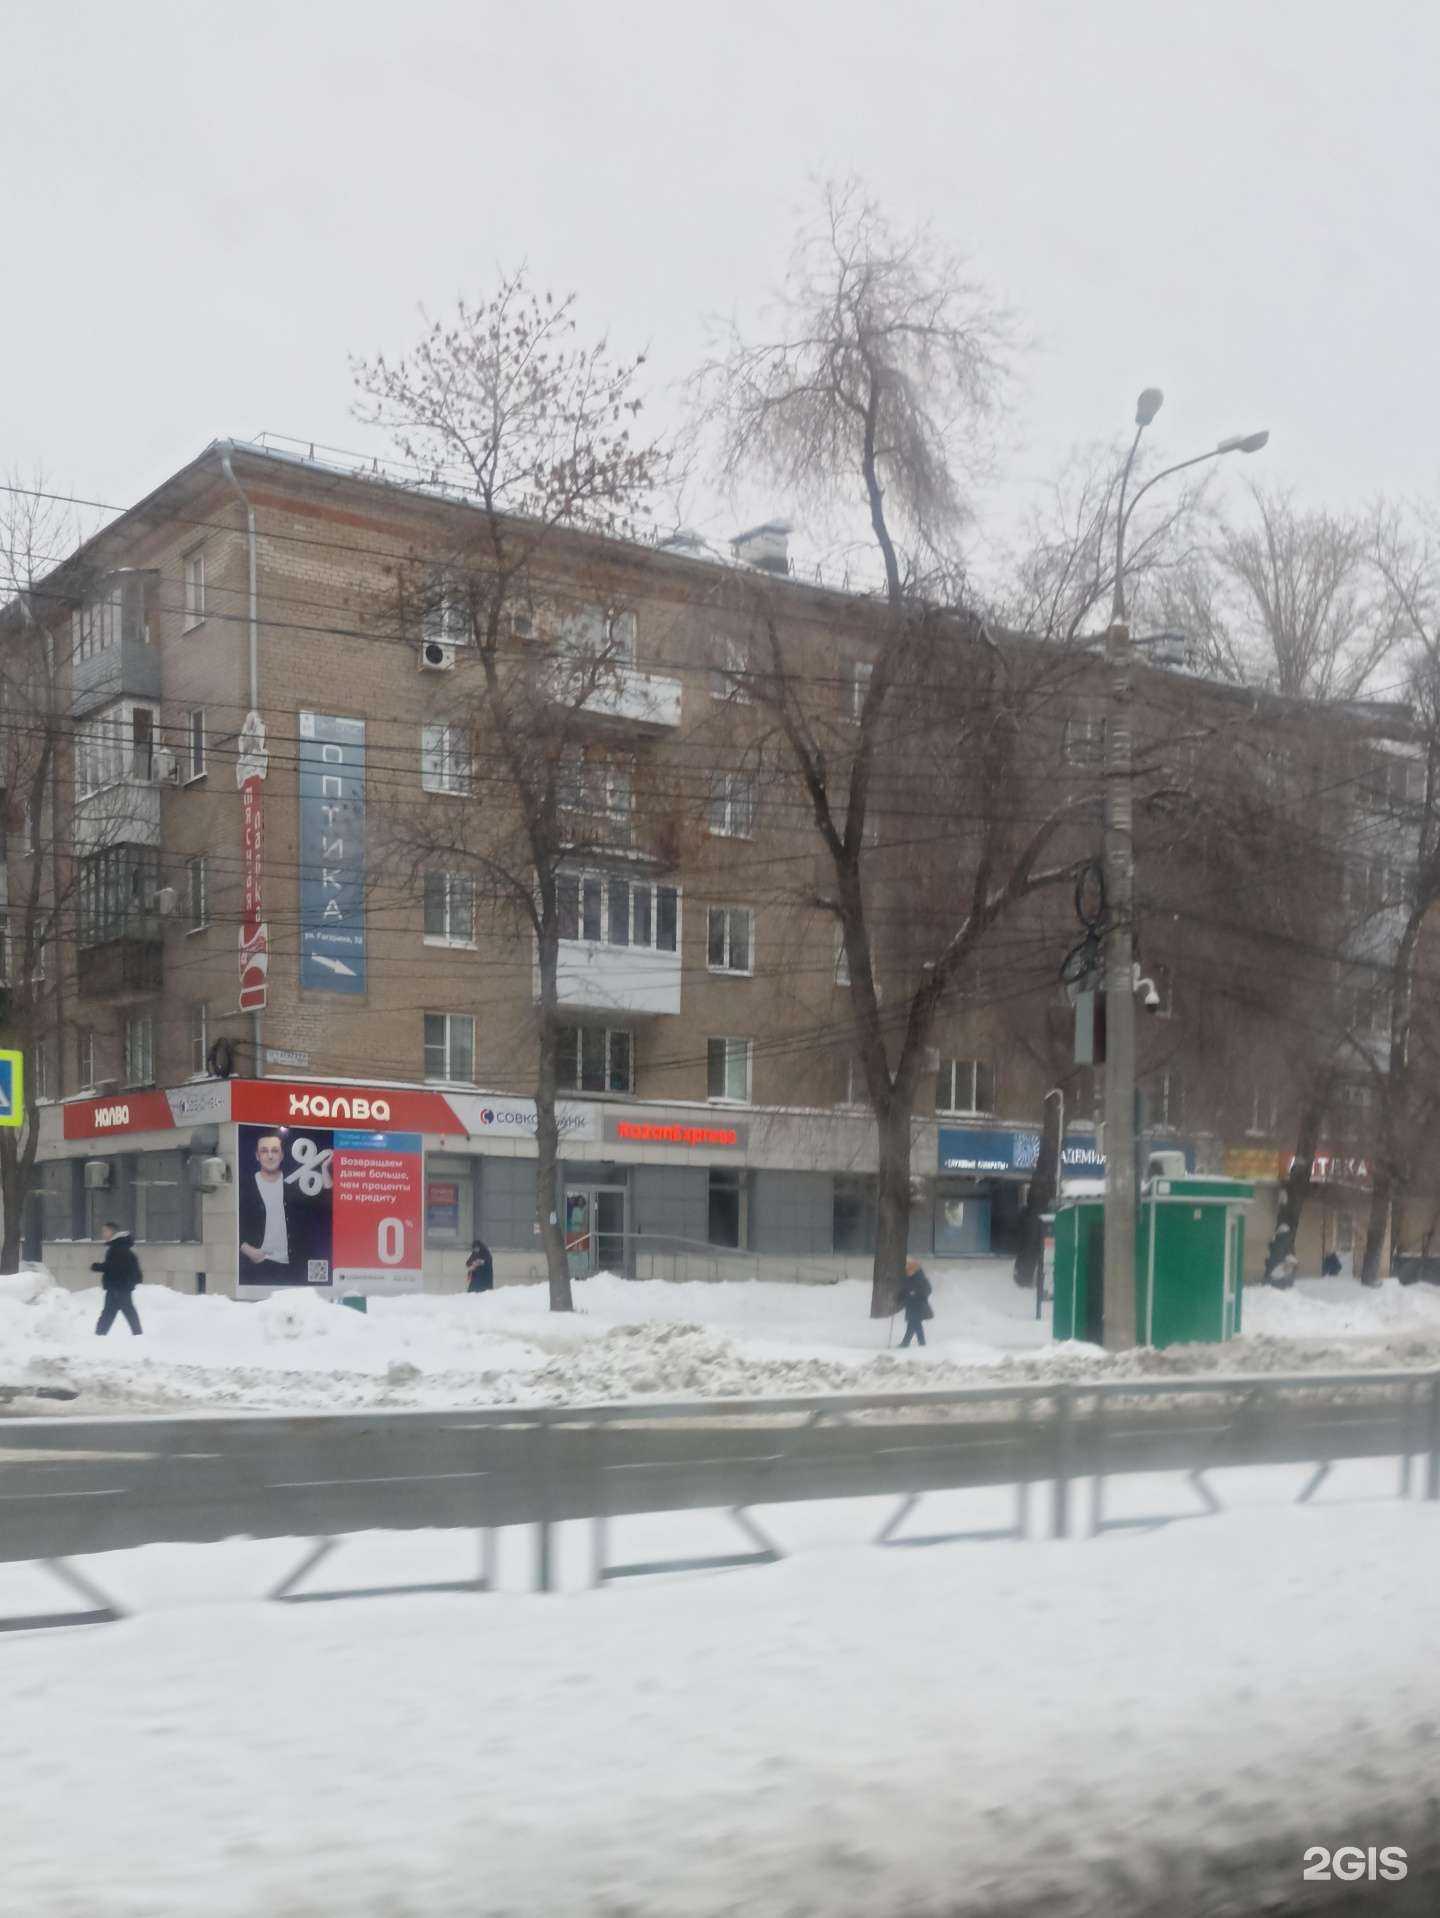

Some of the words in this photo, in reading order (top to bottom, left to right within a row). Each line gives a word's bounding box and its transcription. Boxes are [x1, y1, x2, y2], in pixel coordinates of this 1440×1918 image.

[322, 744, 343, 920] ОПТИКА
[340, 1156, 403, 1168] Возвращаем
[340, 1169, 366, 1179] даже
[340, 1182, 360, 1190] чем
[362, 1183, 411, 1193] проценты
[340, 1193, 353, 1201] по
